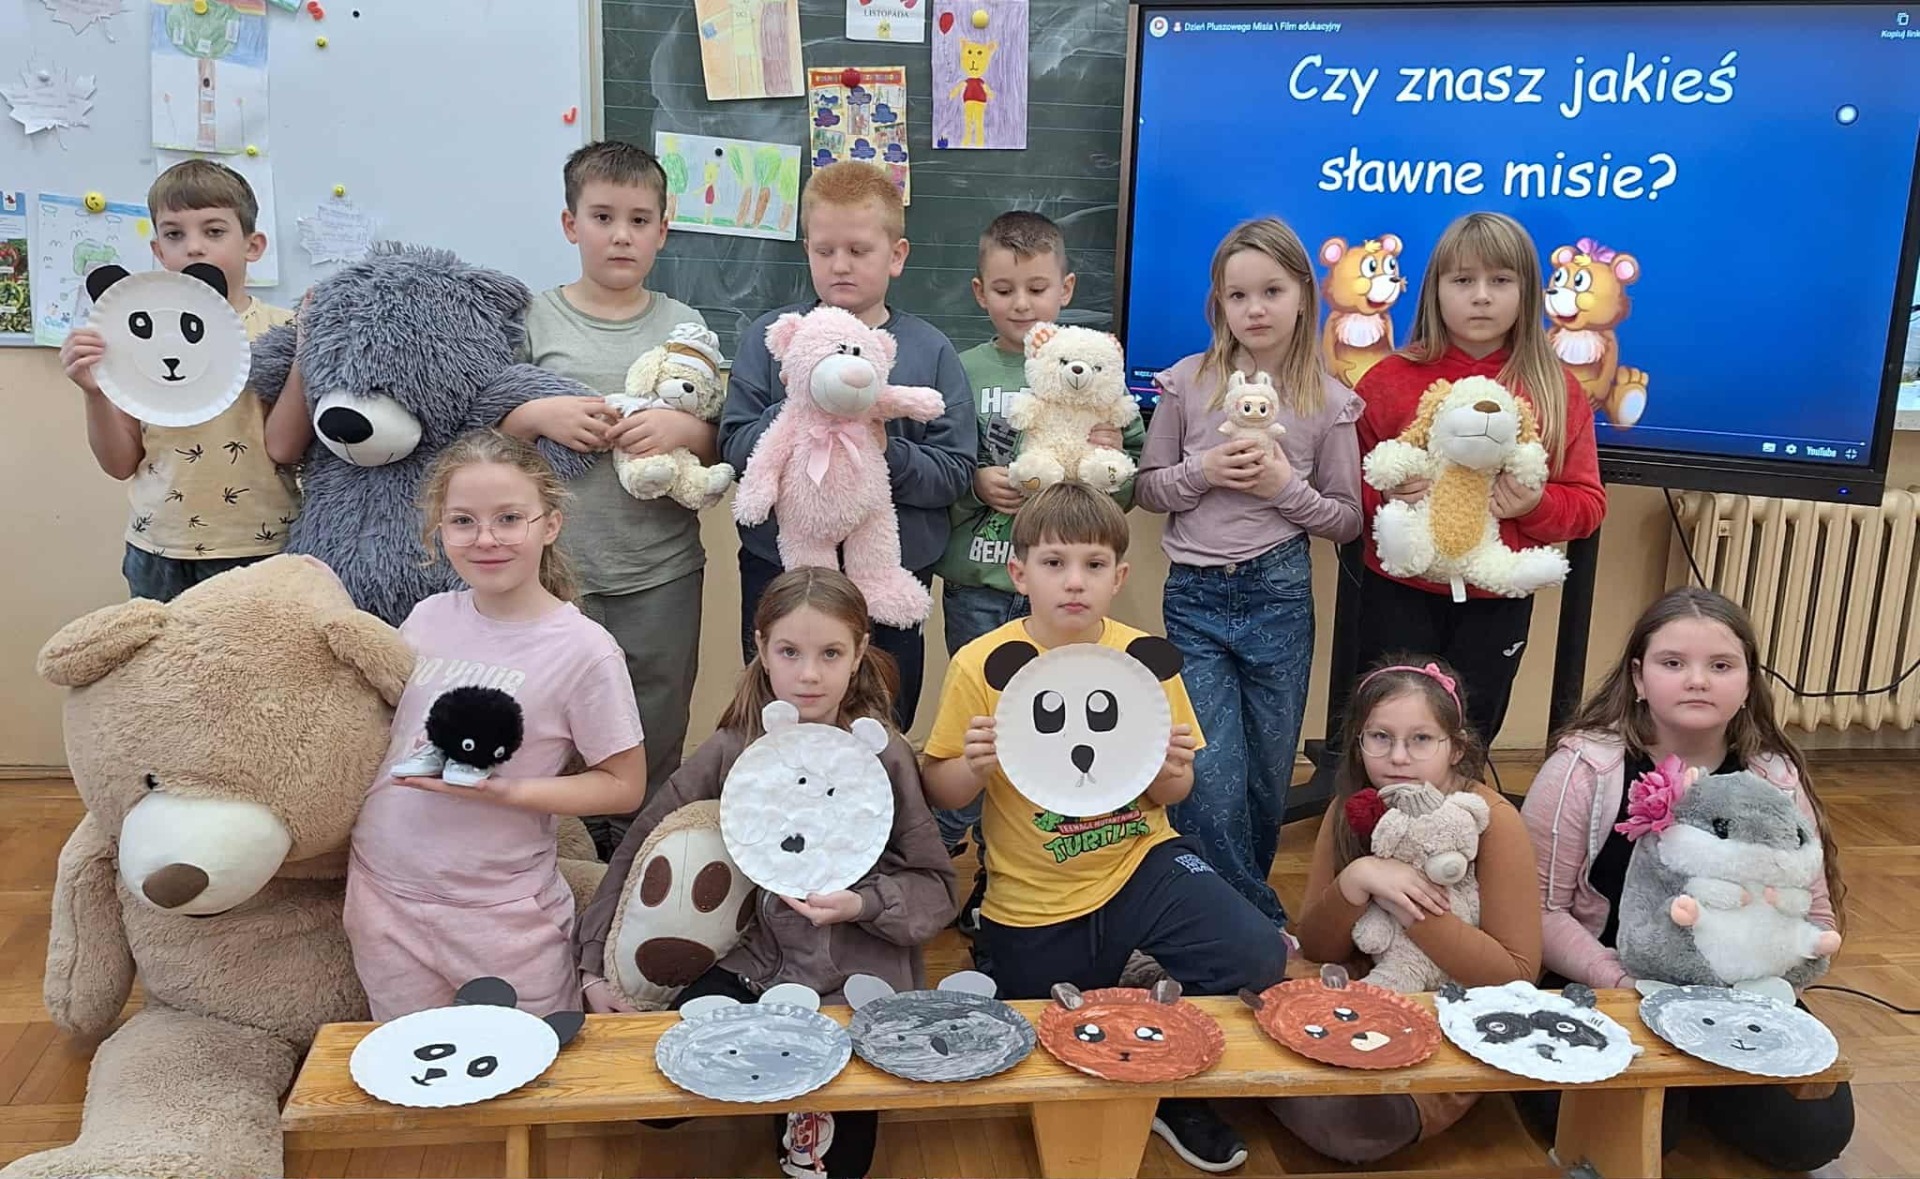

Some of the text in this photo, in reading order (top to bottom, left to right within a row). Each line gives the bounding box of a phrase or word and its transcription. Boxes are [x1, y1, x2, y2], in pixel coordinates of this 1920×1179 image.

[863, 8, 909, 18] LISTOPADA
[1184, 22, 1205, 32] Dzień
[1206, 22, 1251, 33] Pluszowego
[1252, 22, 1274, 32] Misia
[1280, 22, 1297, 31] Film
[1298, 22, 1341, 33] edukacyjny
[1288, 50, 1738, 118] Czy znasz jakieś
[1318, 147, 1678, 201] sławne misie?
[1806, 445, 1838, 458] YouTube
[1043, 817, 1150, 863] TURTLES
